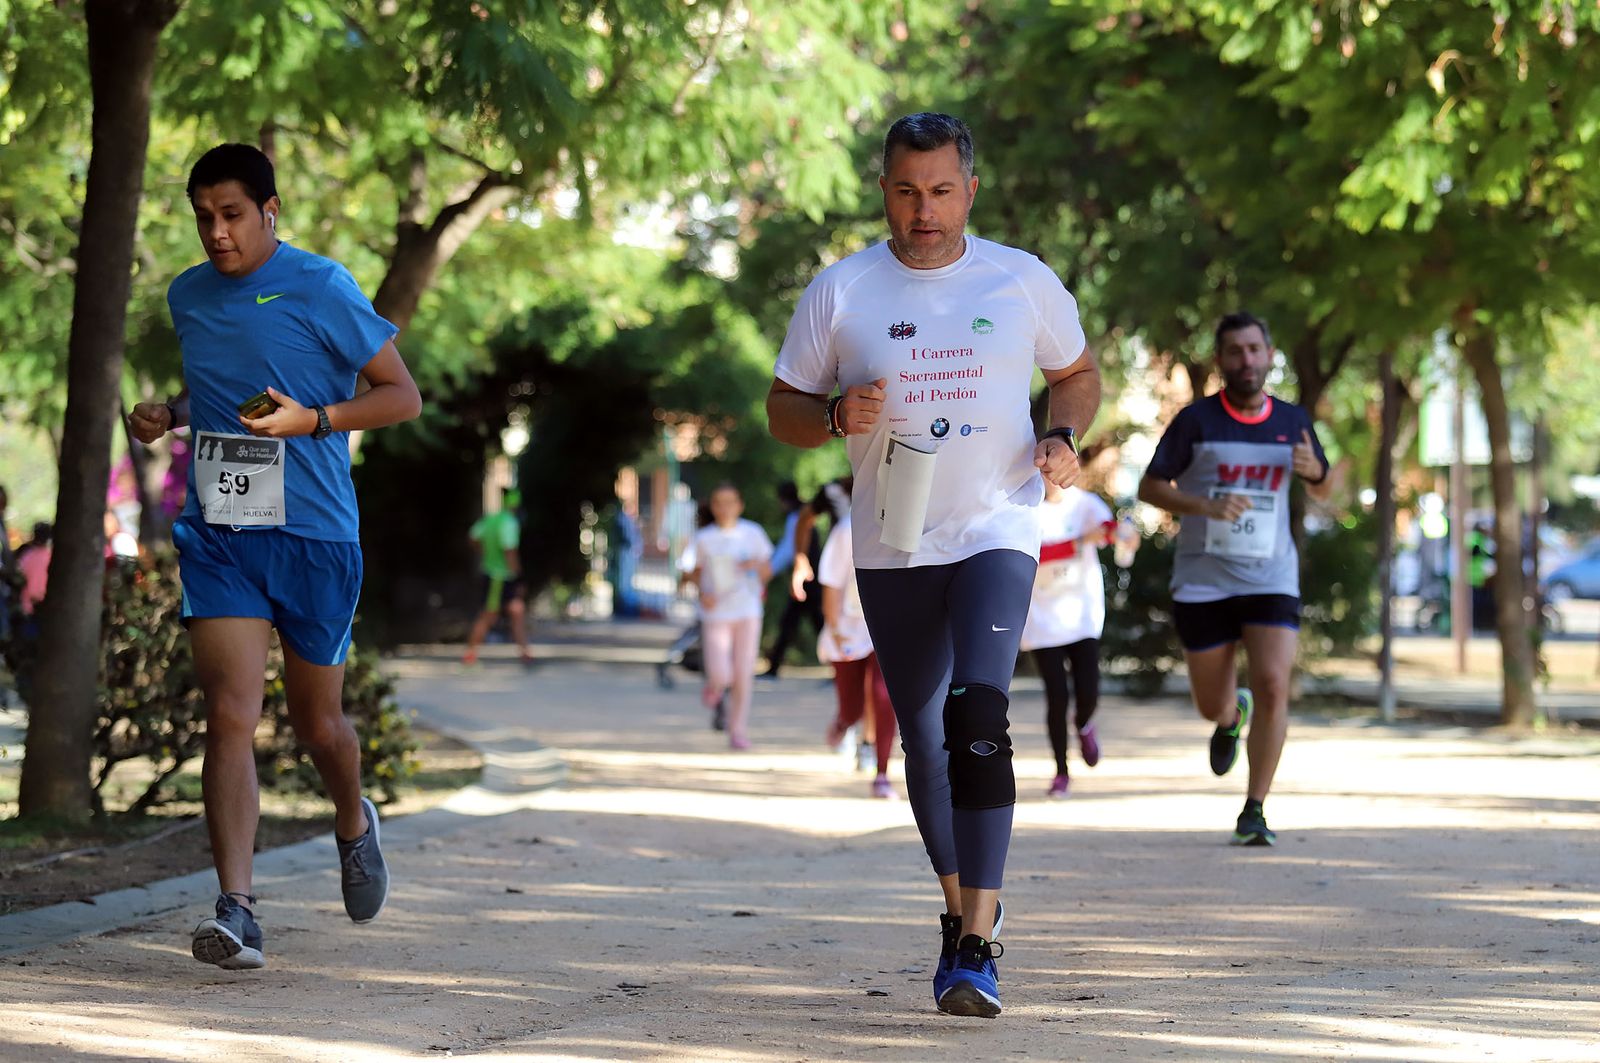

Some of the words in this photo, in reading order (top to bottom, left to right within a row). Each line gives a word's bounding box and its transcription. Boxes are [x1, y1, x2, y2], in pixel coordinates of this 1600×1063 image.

[911, 348, 917, 361] I
[921, 347, 973, 359] Carrera
[899, 365, 983, 383] Sacramental
[904, 390, 925, 403] del
[930, 387, 977, 401] Perdón
[218, 472, 250, 495] 59
[1231, 517, 1255, 534] 56
